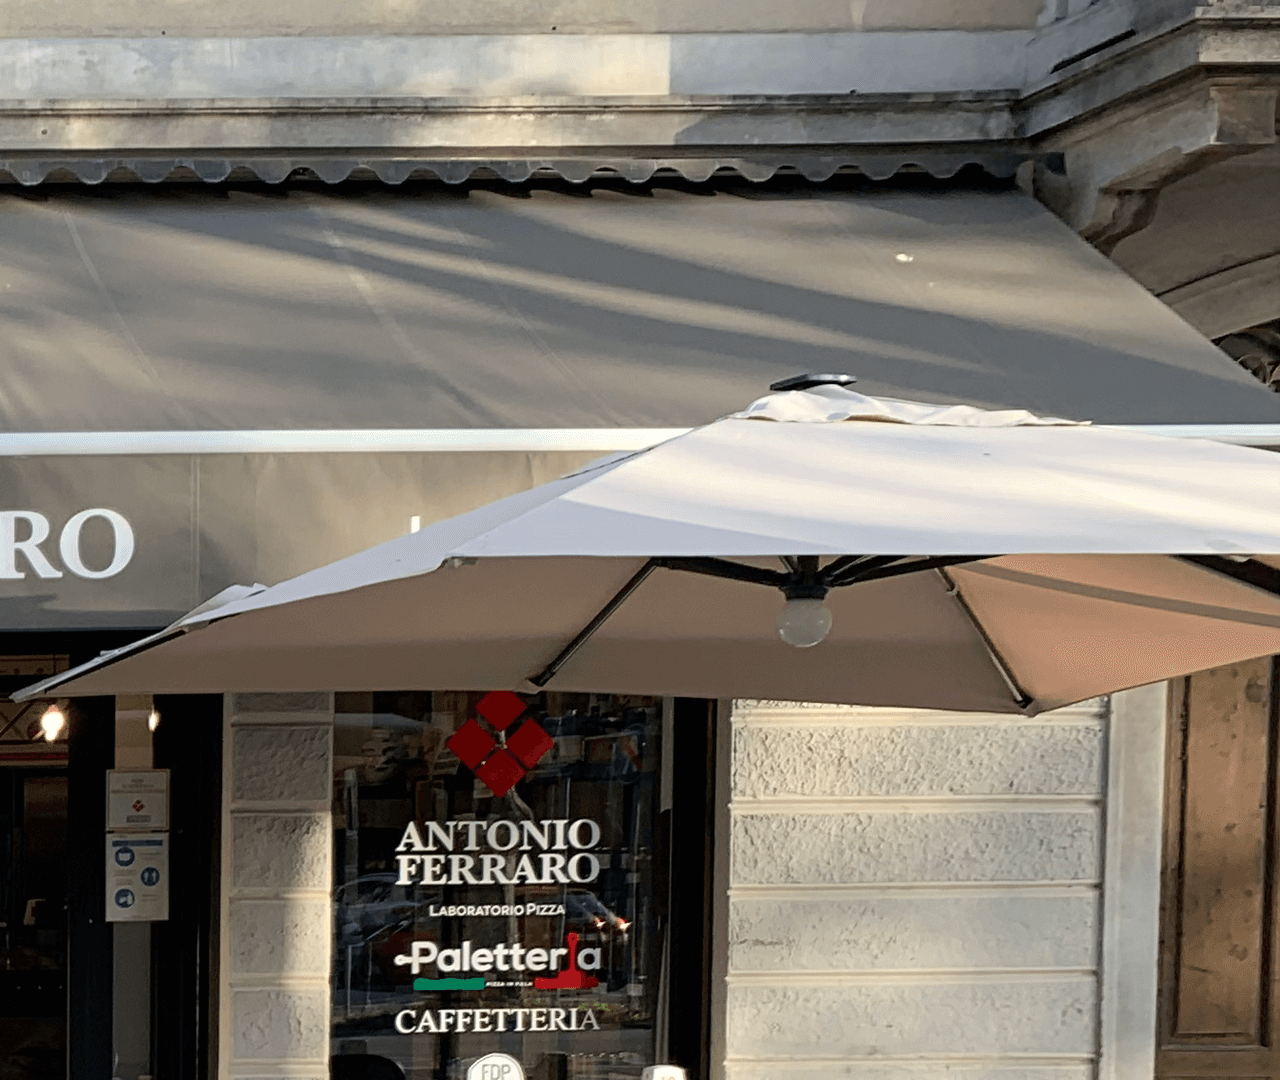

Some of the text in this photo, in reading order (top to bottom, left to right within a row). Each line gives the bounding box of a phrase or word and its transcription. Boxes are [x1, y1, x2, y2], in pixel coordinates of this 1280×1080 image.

[395, 818, 601, 851] ANTONIO
[395, 852, 600, 886] FERRARO
[394, 1007, 601, 1035] CAFFETTERIA
[481, 1063, 511, 1080] FDP
